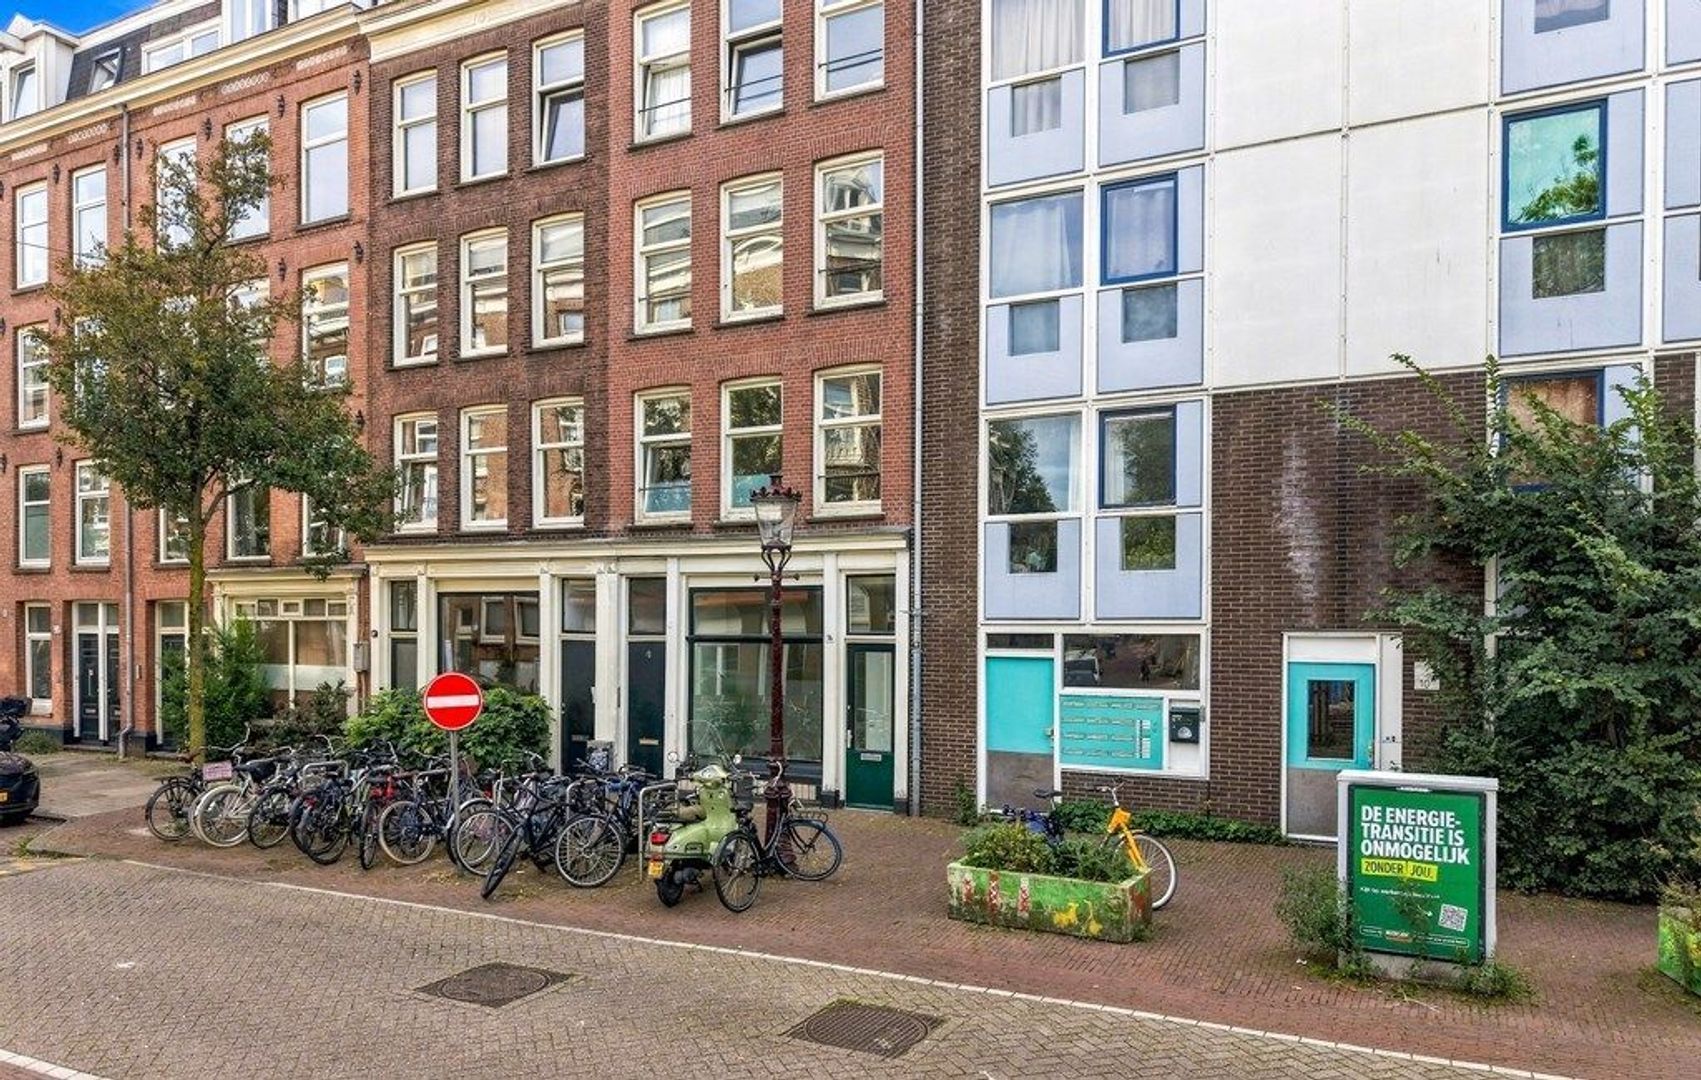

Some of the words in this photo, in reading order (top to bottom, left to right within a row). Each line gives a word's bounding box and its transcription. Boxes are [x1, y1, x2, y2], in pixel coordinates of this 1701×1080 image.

[1361, 805, 1382, 822] DE
[1385, 807, 1462, 828] ENERGIE-
[1361, 822, 1445, 845] TRANSITIE
[1448, 829, 1465, 846] IS
[1361, 839, 1471, 865] ONMOGELIJK
[1364, 861, 1404, 874] ZONDER
